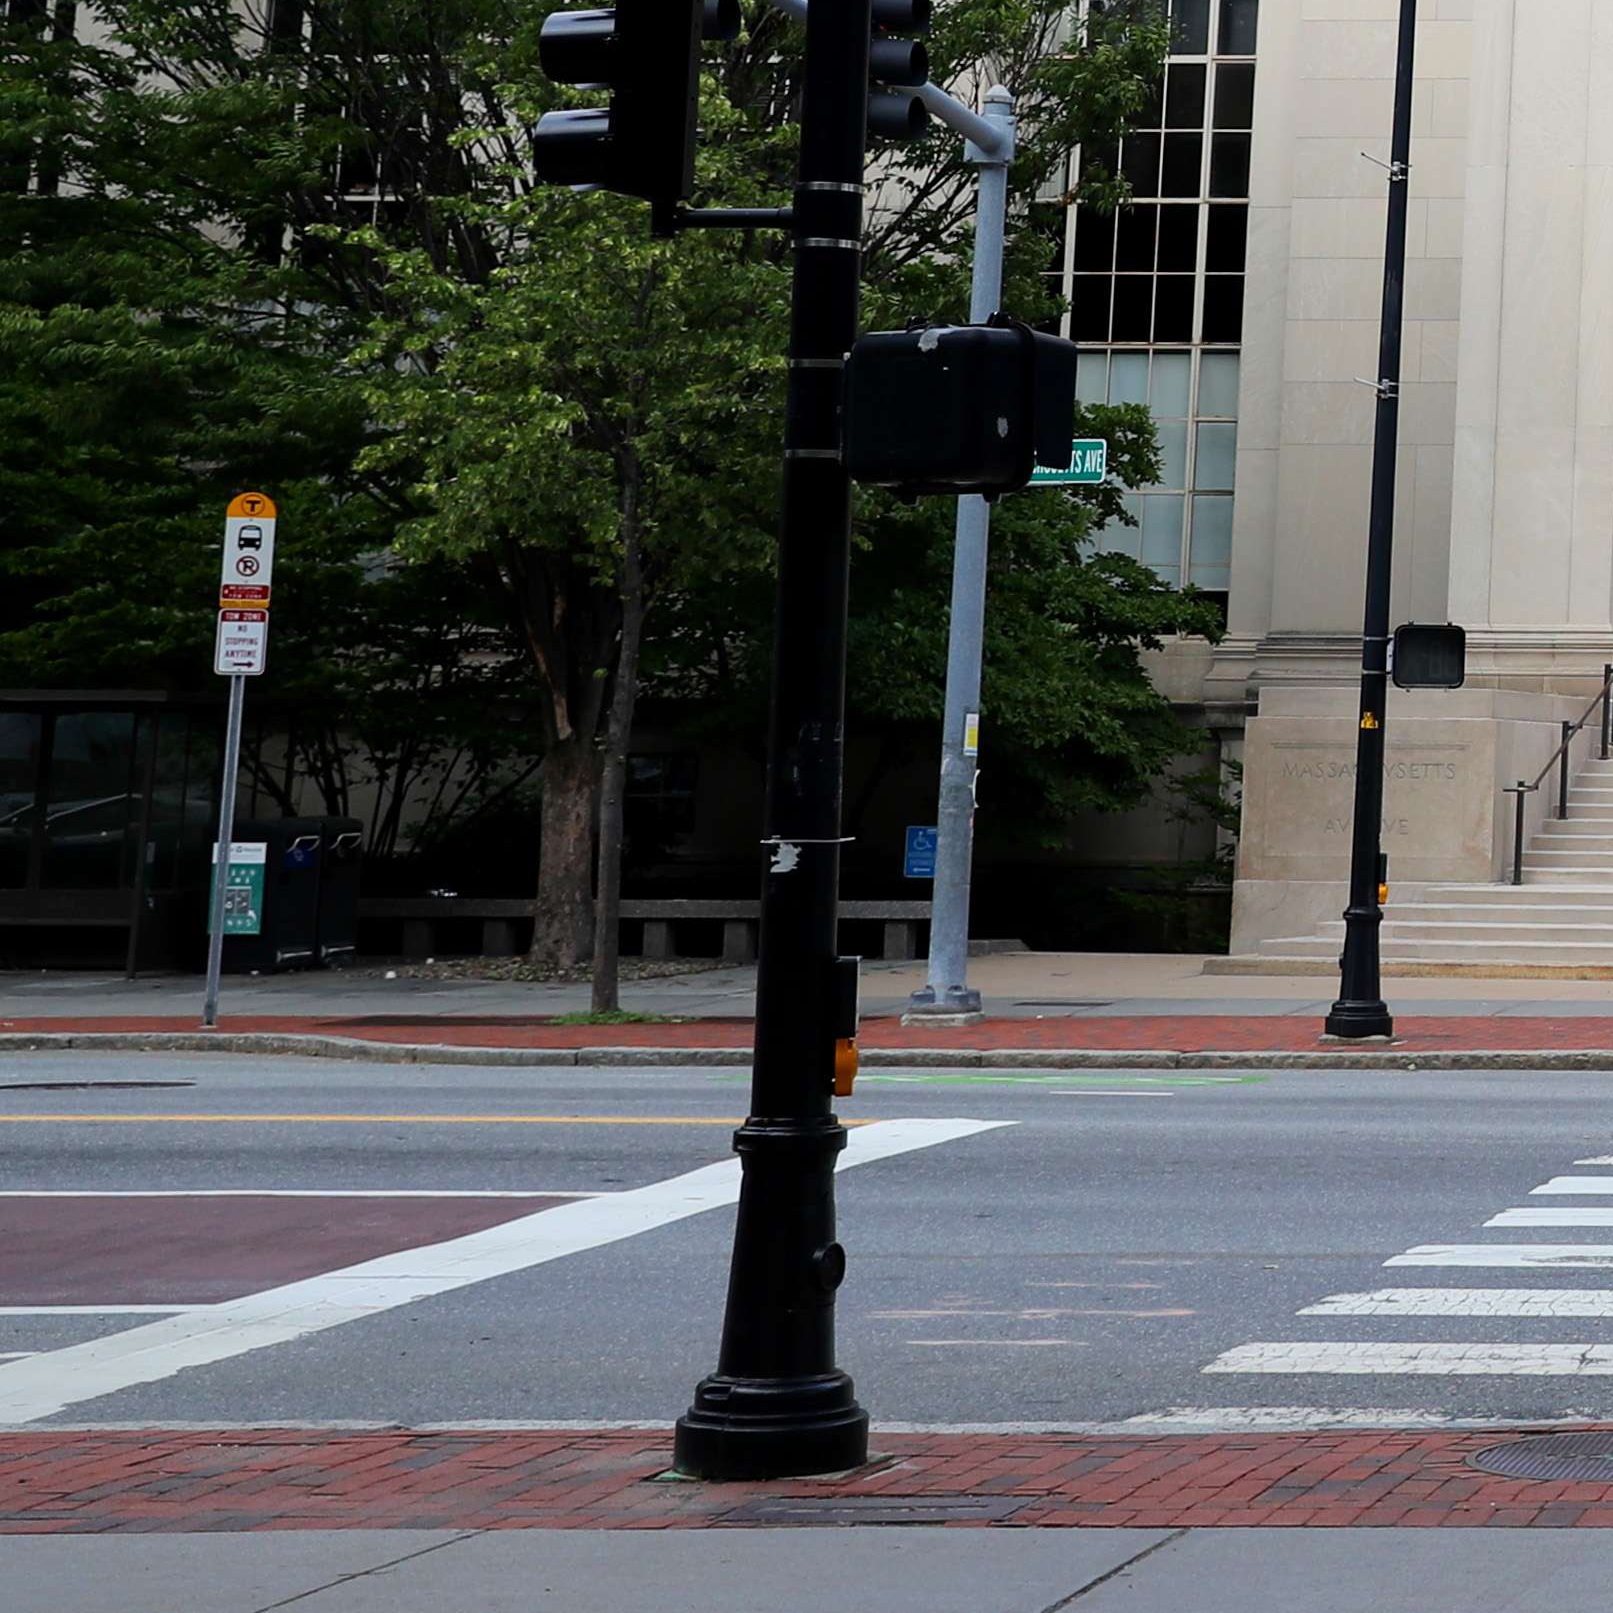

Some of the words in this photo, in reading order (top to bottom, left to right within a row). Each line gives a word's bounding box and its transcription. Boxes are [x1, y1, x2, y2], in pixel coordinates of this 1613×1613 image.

[1083, 449, 1103, 473] AVE
[1283, 762, 1456, 780] MASSAVSETTS
[1323, 819, 1409, 835] AVVE
